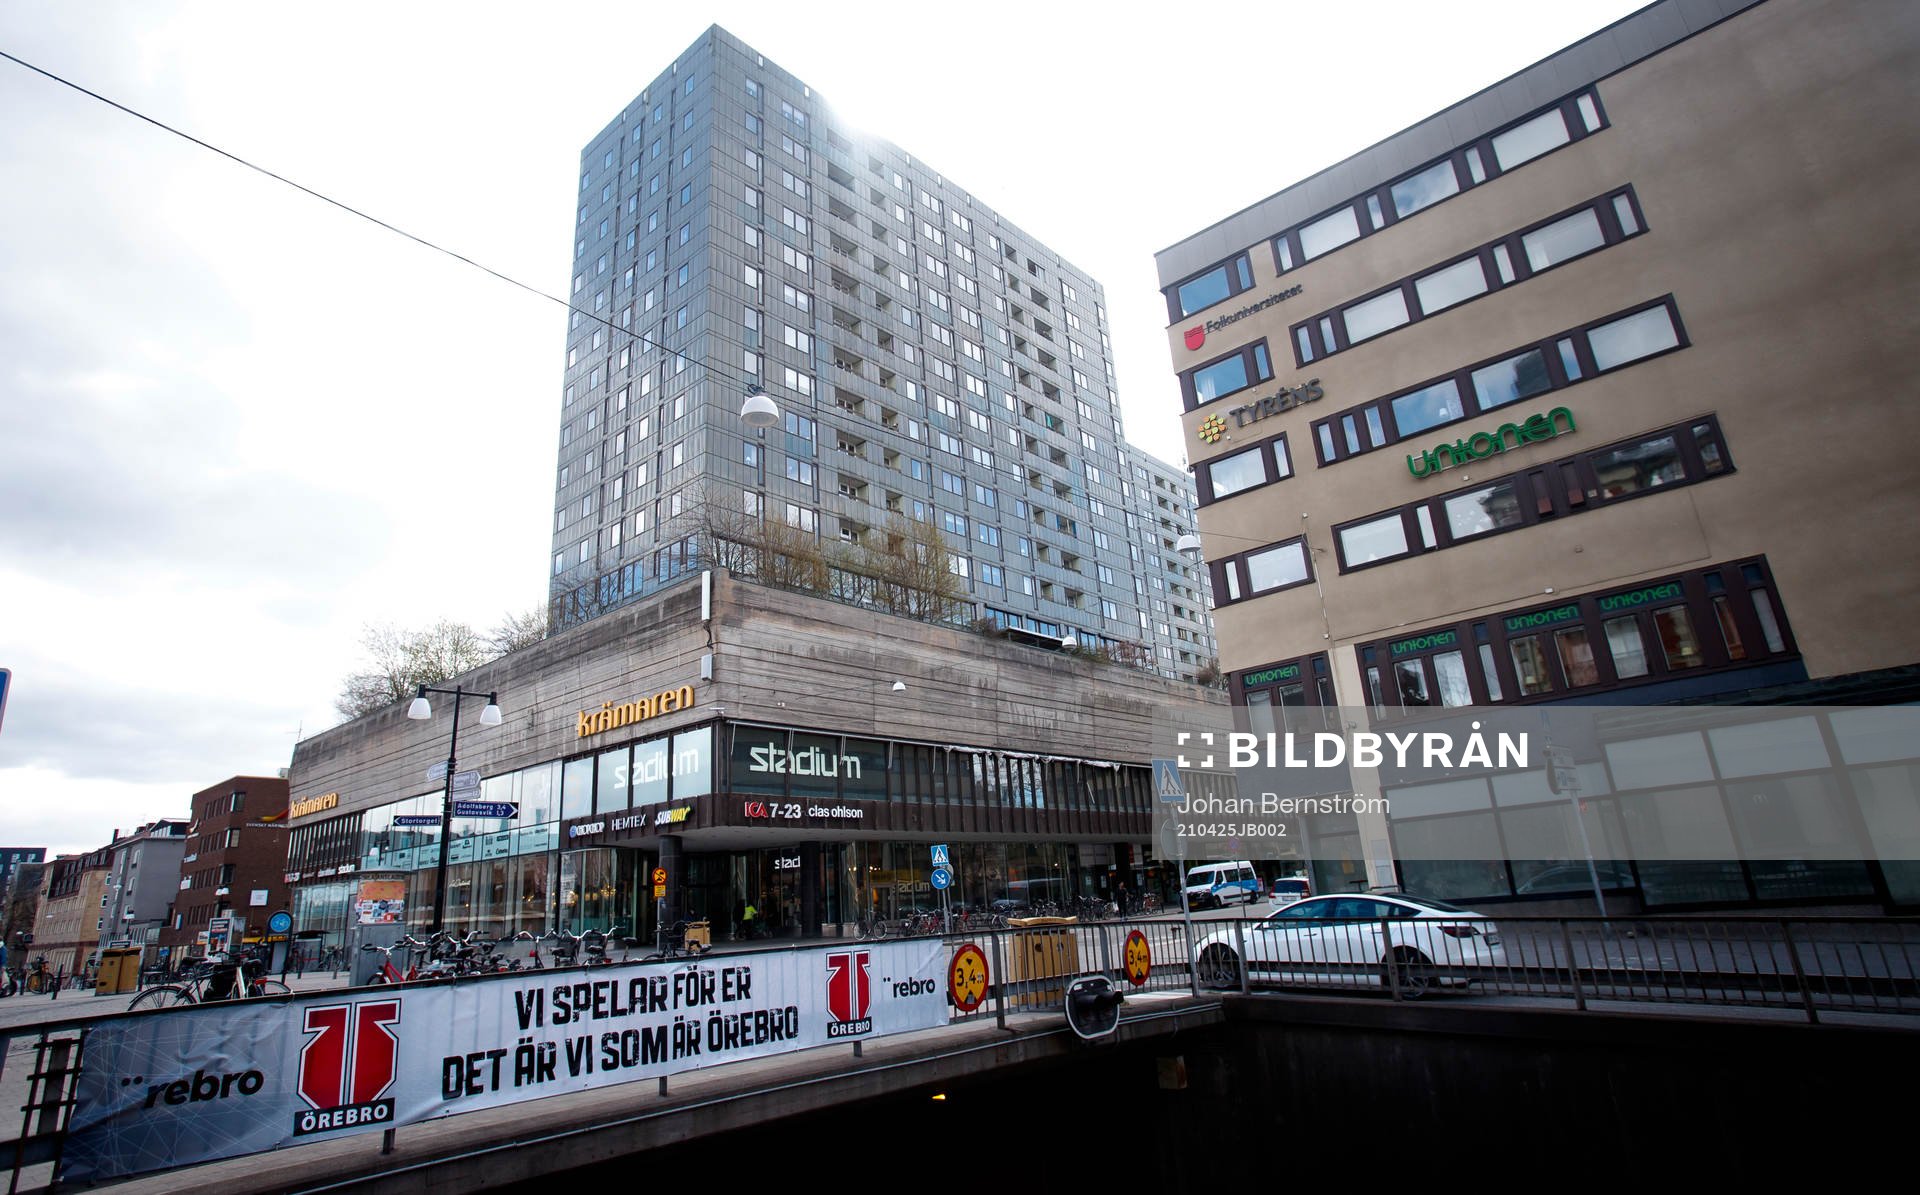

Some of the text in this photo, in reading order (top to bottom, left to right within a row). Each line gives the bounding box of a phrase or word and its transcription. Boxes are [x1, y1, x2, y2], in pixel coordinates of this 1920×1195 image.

[1229, 378, 1325, 427] TYRÉNS
[578, 685, 695, 737] krämaren
[614, 748, 699, 789] sadium
[749, 742, 861, 779] stadium
[612, 814, 647, 832] HEMTEX
[655, 806, 690, 826] SUBWAY
[744, 801, 802, 819] ICA 7-23
[808, 804, 863, 819] clas ohlson
[514, 965, 752, 1031] VI SPELAR FÖR ER
[830, 1020, 870, 1036] ÖREBRO
[441, 1005, 799, 1101] DET ÄR VI SOM ÄR ÖREBRO
[301, 1104, 388, 1132] ÖREBRO
